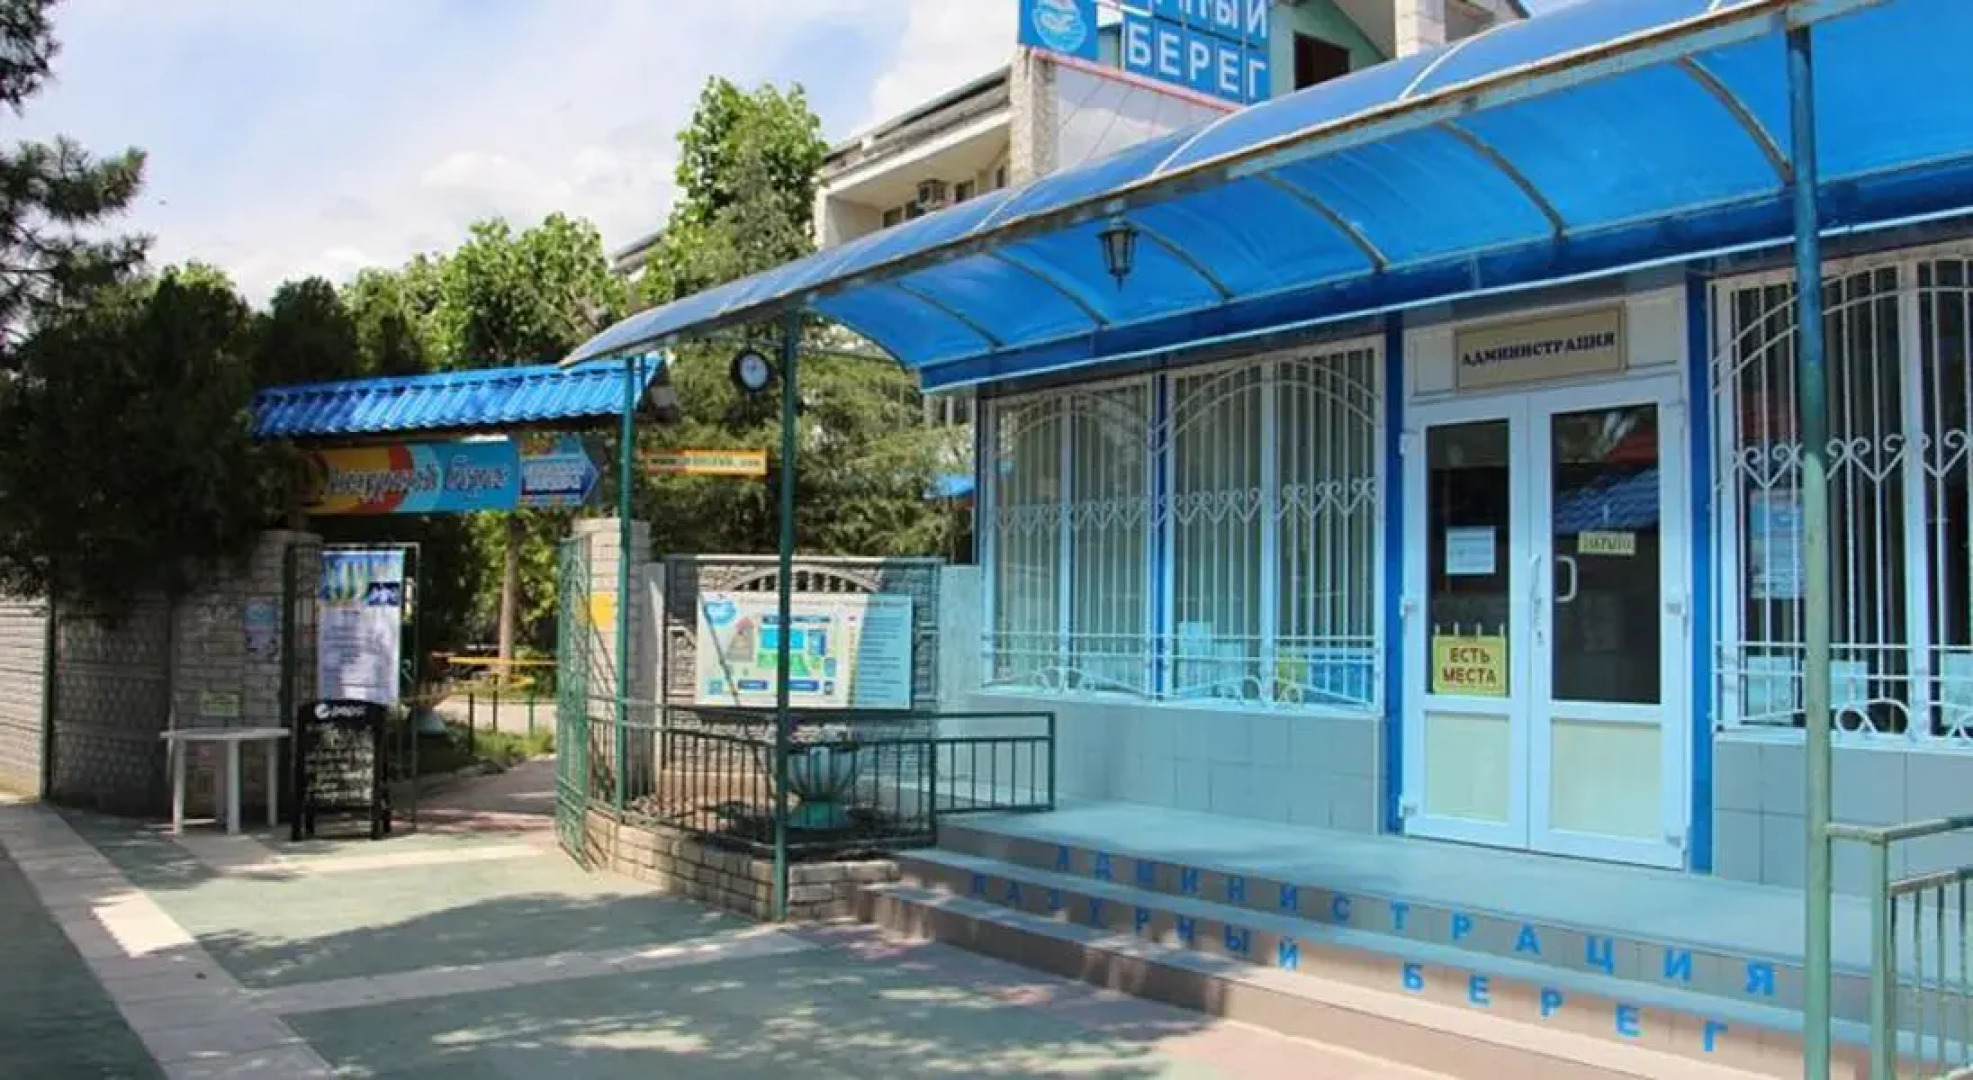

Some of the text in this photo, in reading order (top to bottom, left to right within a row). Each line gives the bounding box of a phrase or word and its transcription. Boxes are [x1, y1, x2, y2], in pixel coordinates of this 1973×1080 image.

[1127, 23, 1268, 98] БЕРЕГ
[1462, 330, 1615, 368] АДМИНИСТРАЦИЯ
[1442, 667, 1497, 685] МЕСТА
[1449, 647, 1491, 664] ЕСТЬ
[1055, 844, 1776, 997] АДМИНИСТРАЦИЯ
[1402, 962, 1728, 1052] БЕРЕГ
